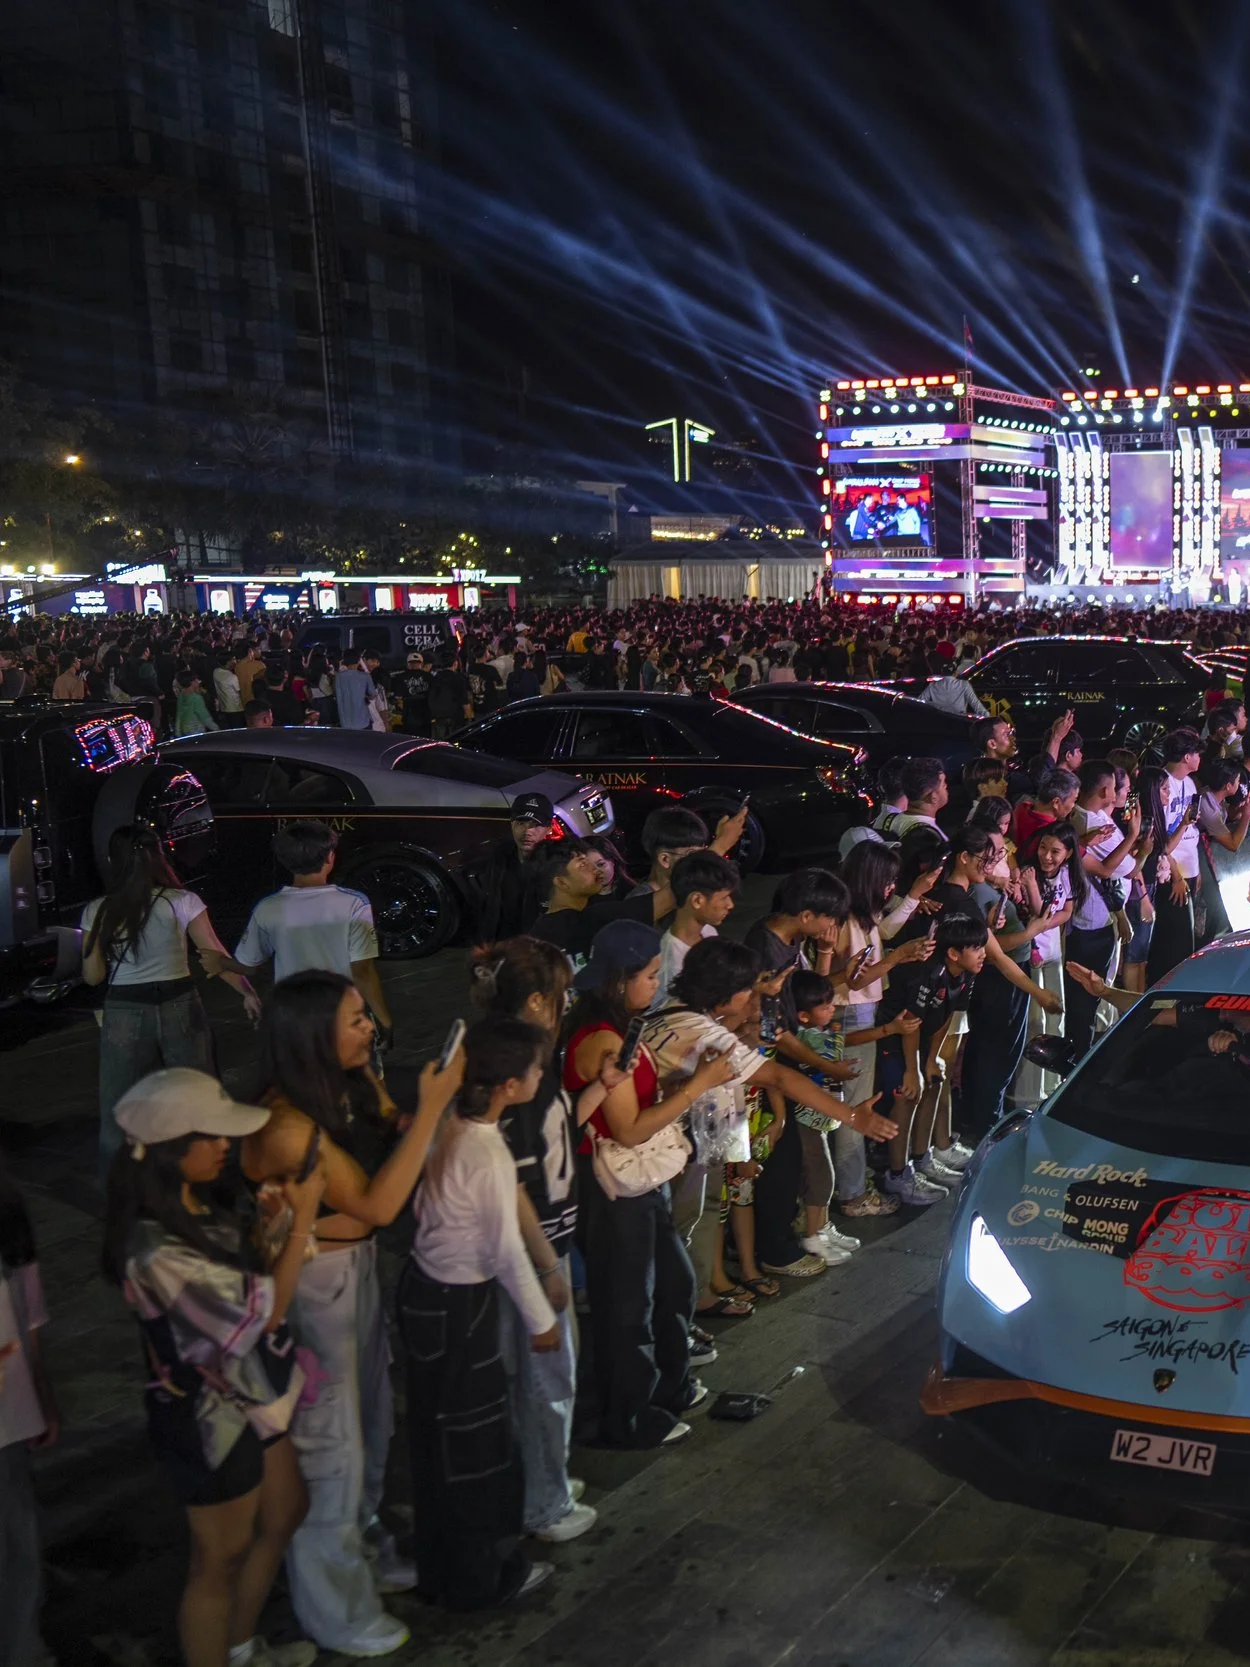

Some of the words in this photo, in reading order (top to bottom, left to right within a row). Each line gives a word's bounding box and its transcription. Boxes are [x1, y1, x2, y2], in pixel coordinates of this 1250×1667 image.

[404, 624, 440, 635] CELL
[404, 635, 441, 646] CERA
[1032, 1160, 1096, 1180] Hard
[1020, 1184, 1060, 1199] BANG
[1075, 1194, 1140, 1212] OLUFSEN
[1043, 1207, 1080, 1226] CHIP
[1083, 1218, 1130, 1235] MONG
[1089, 1315, 1180, 1343] SAIGON
[1115, 1433, 1152, 1462] W2
[1158, 1440, 1213, 1471] JVR
